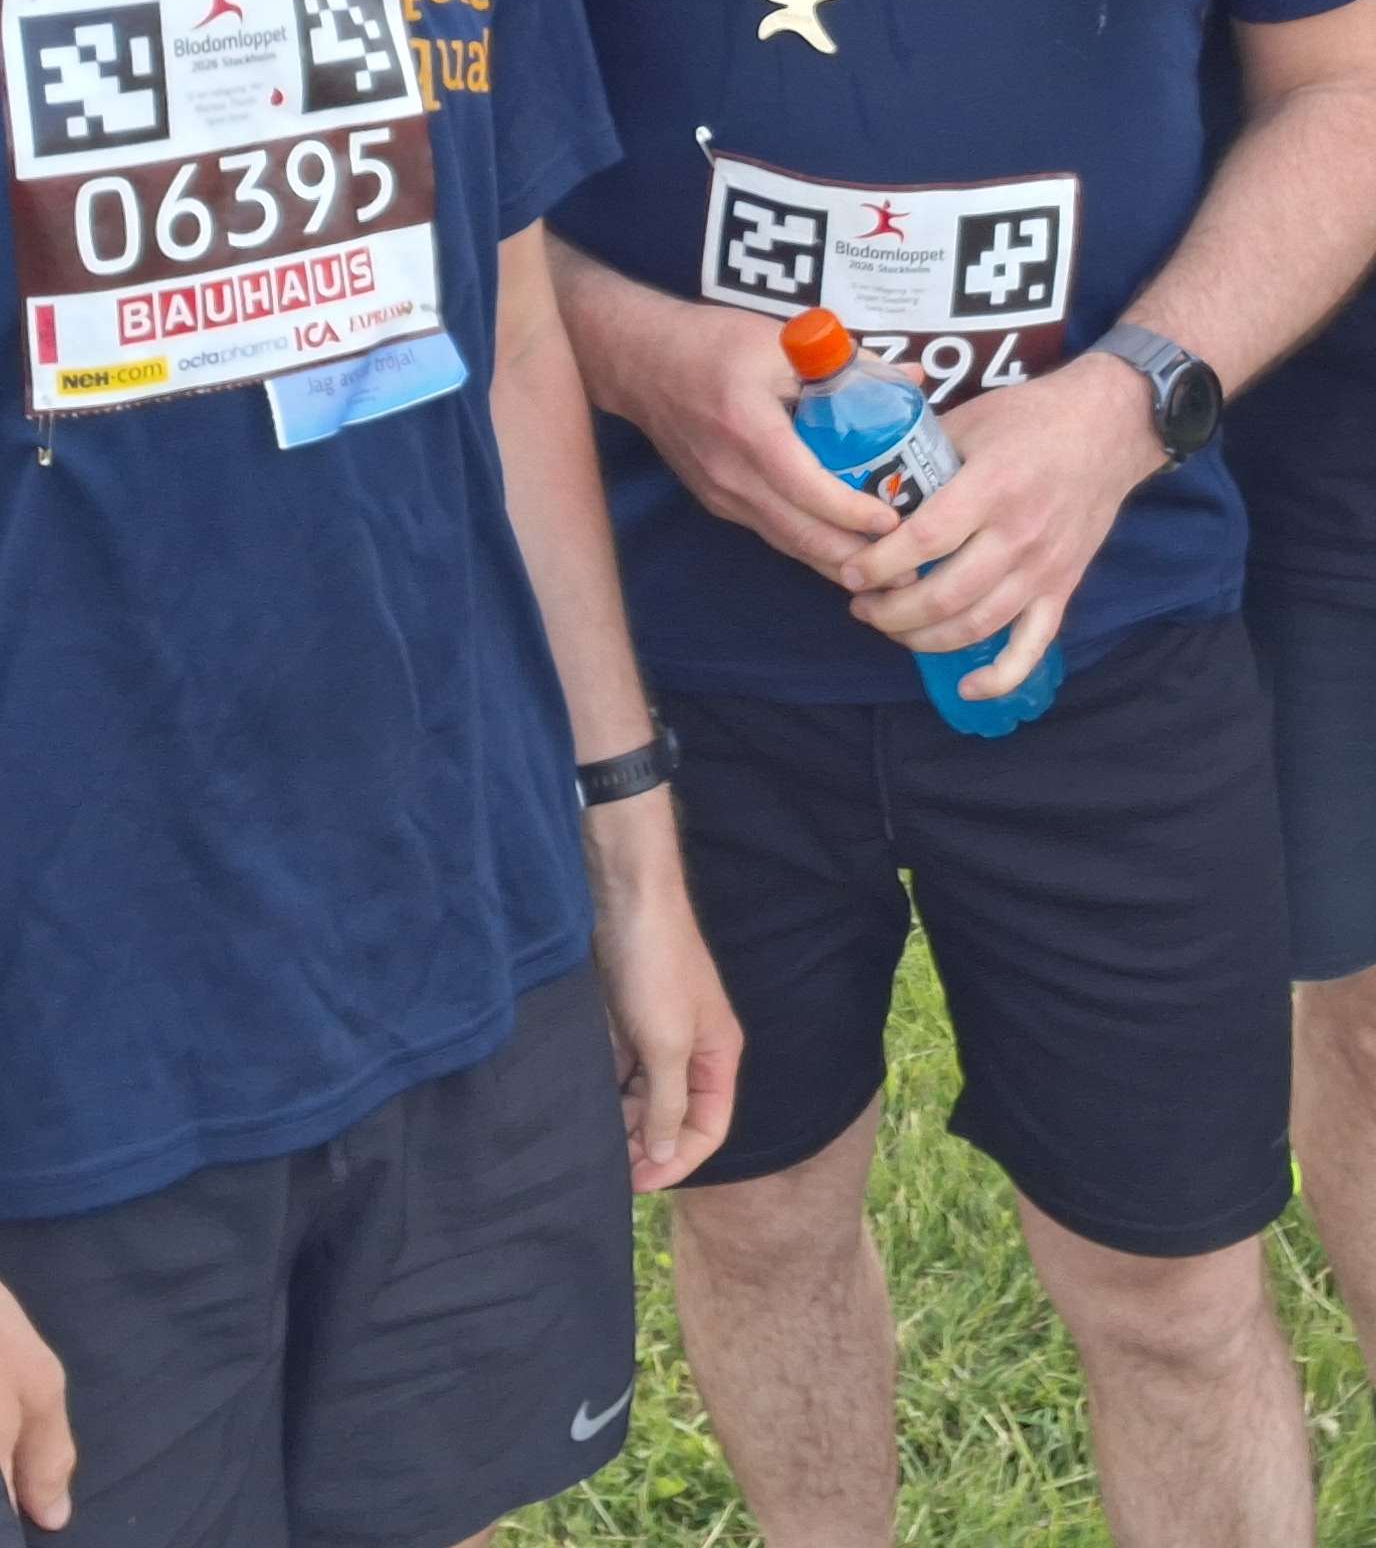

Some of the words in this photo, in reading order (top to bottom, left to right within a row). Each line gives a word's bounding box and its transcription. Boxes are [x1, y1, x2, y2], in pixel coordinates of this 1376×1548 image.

[173, 25, 287, 58] Blodomloppet
[74, 128, 395, 276] 06395
[834, 240, 945, 265] Blodomloppet
[119, 248, 375, 344] BAUHAUS
[177, 334, 289, 372] octapharma
[293, 319, 341, 352] ICA
